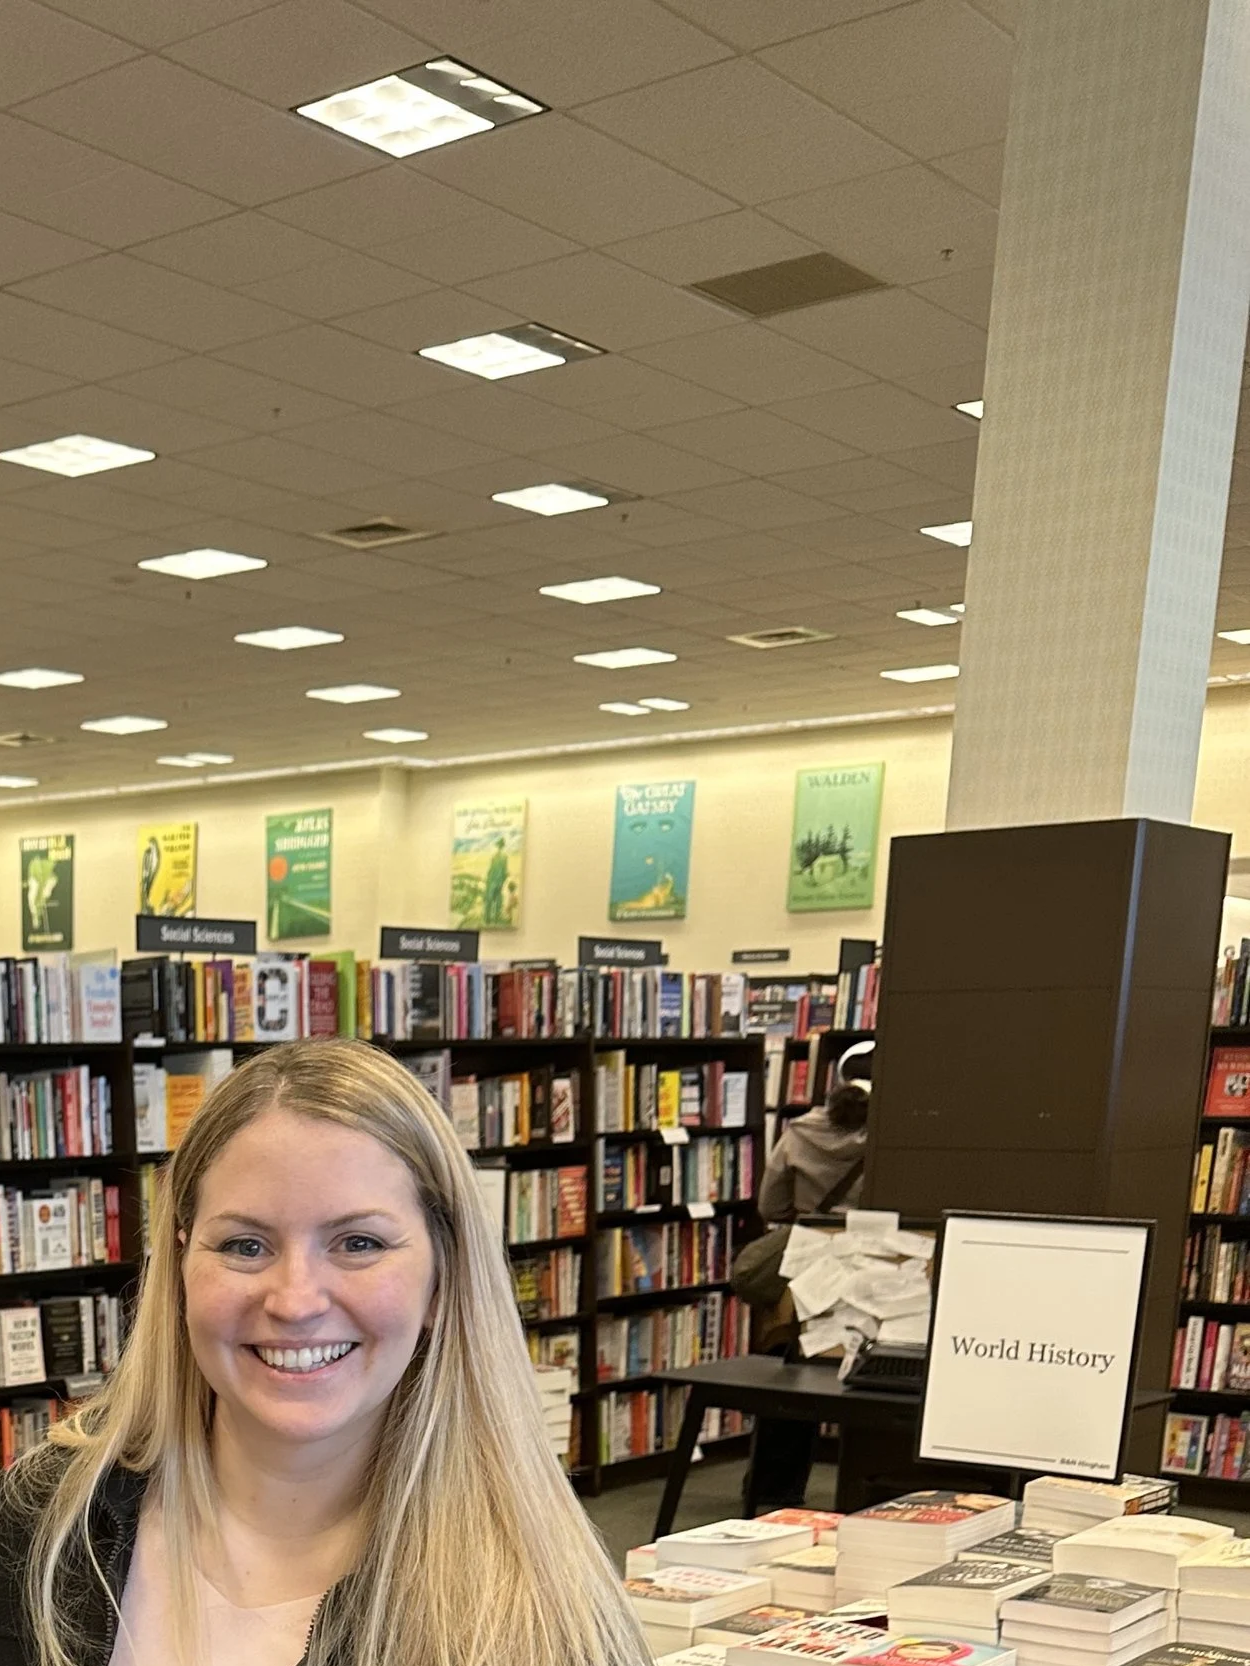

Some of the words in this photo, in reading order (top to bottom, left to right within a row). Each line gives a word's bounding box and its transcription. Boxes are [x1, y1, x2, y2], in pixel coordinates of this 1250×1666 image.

[807, 772, 870, 788] WALDEN
[644, 783, 687, 799] GREAT
[623, 799, 678, 816] GATSBY
[160, 924, 191, 942] Social
[192, 925, 235, 944] Sciences
[399, 934, 424, 951] Social
[426, 936, 461, 952] Sciences
[594, 944, 615, 959] Social
[616, 946, 646, 961] Sciences
[951, 1335, 1020, 1361] World
[1026, 1342, 1116, 1374] History
